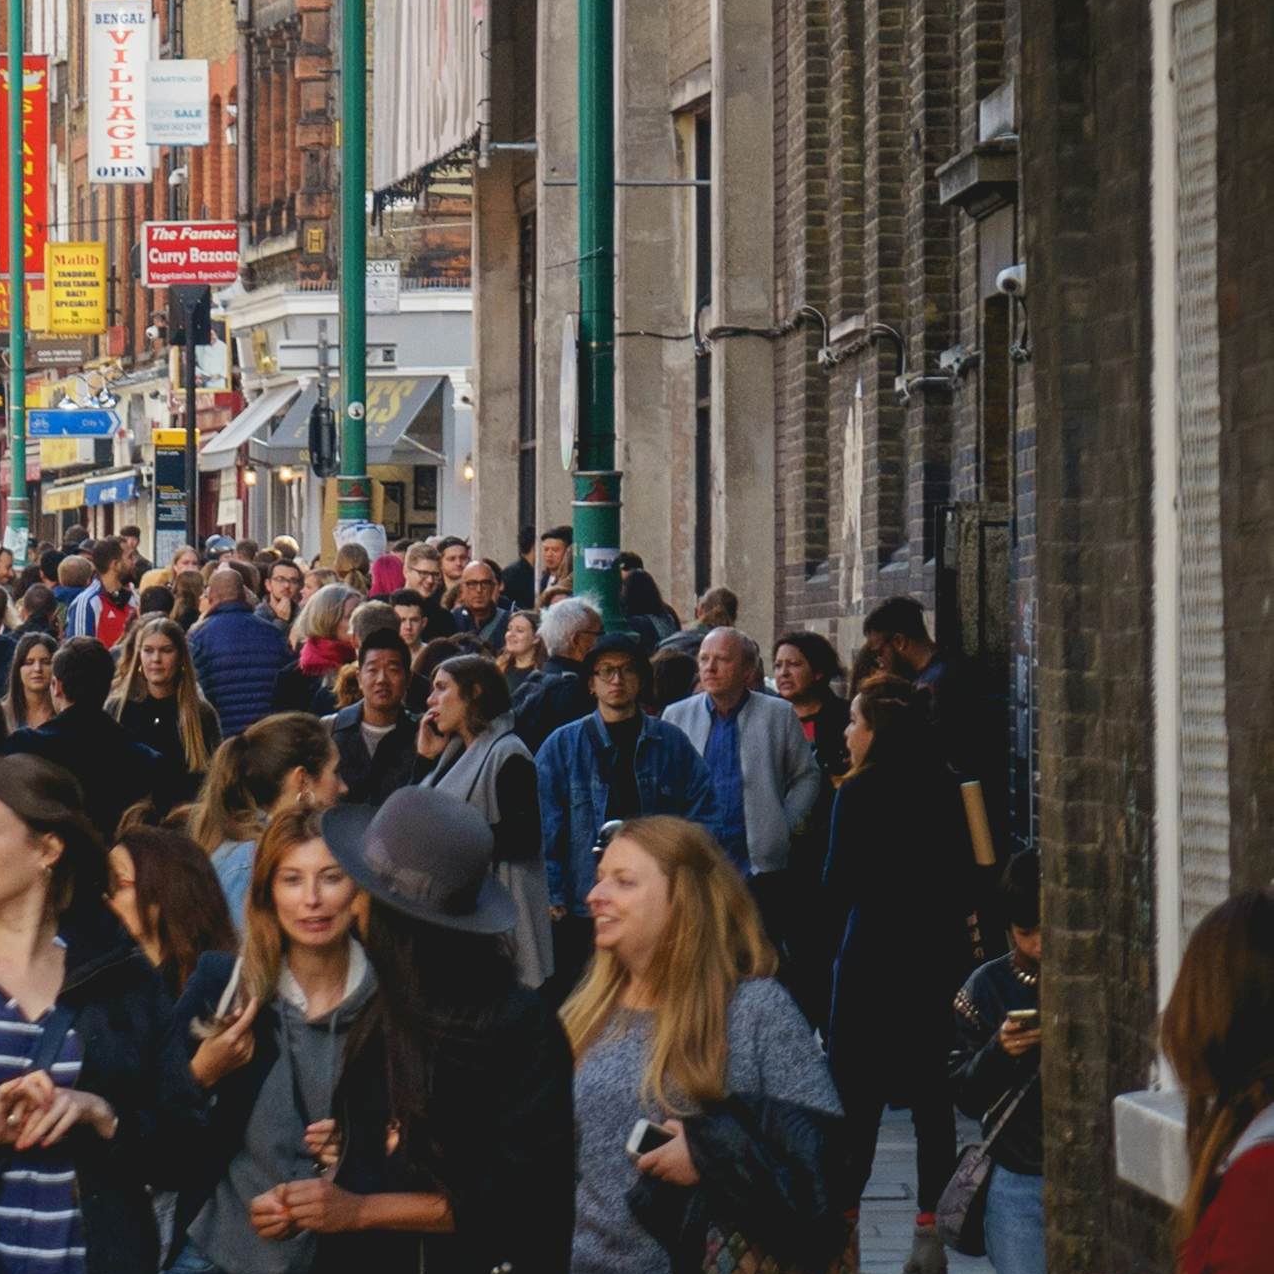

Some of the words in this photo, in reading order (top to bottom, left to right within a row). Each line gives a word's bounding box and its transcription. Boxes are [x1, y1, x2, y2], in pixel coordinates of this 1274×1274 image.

[94, 13, 146, 25] BENGAL
[106, 29, 136, 160] VILLAGE
[174, 109, 202, 118] SALE
[96, 166, 147, 177] OPEN
[152, 227, 178, 241] The
[149, 247, 188, 266] Curry
